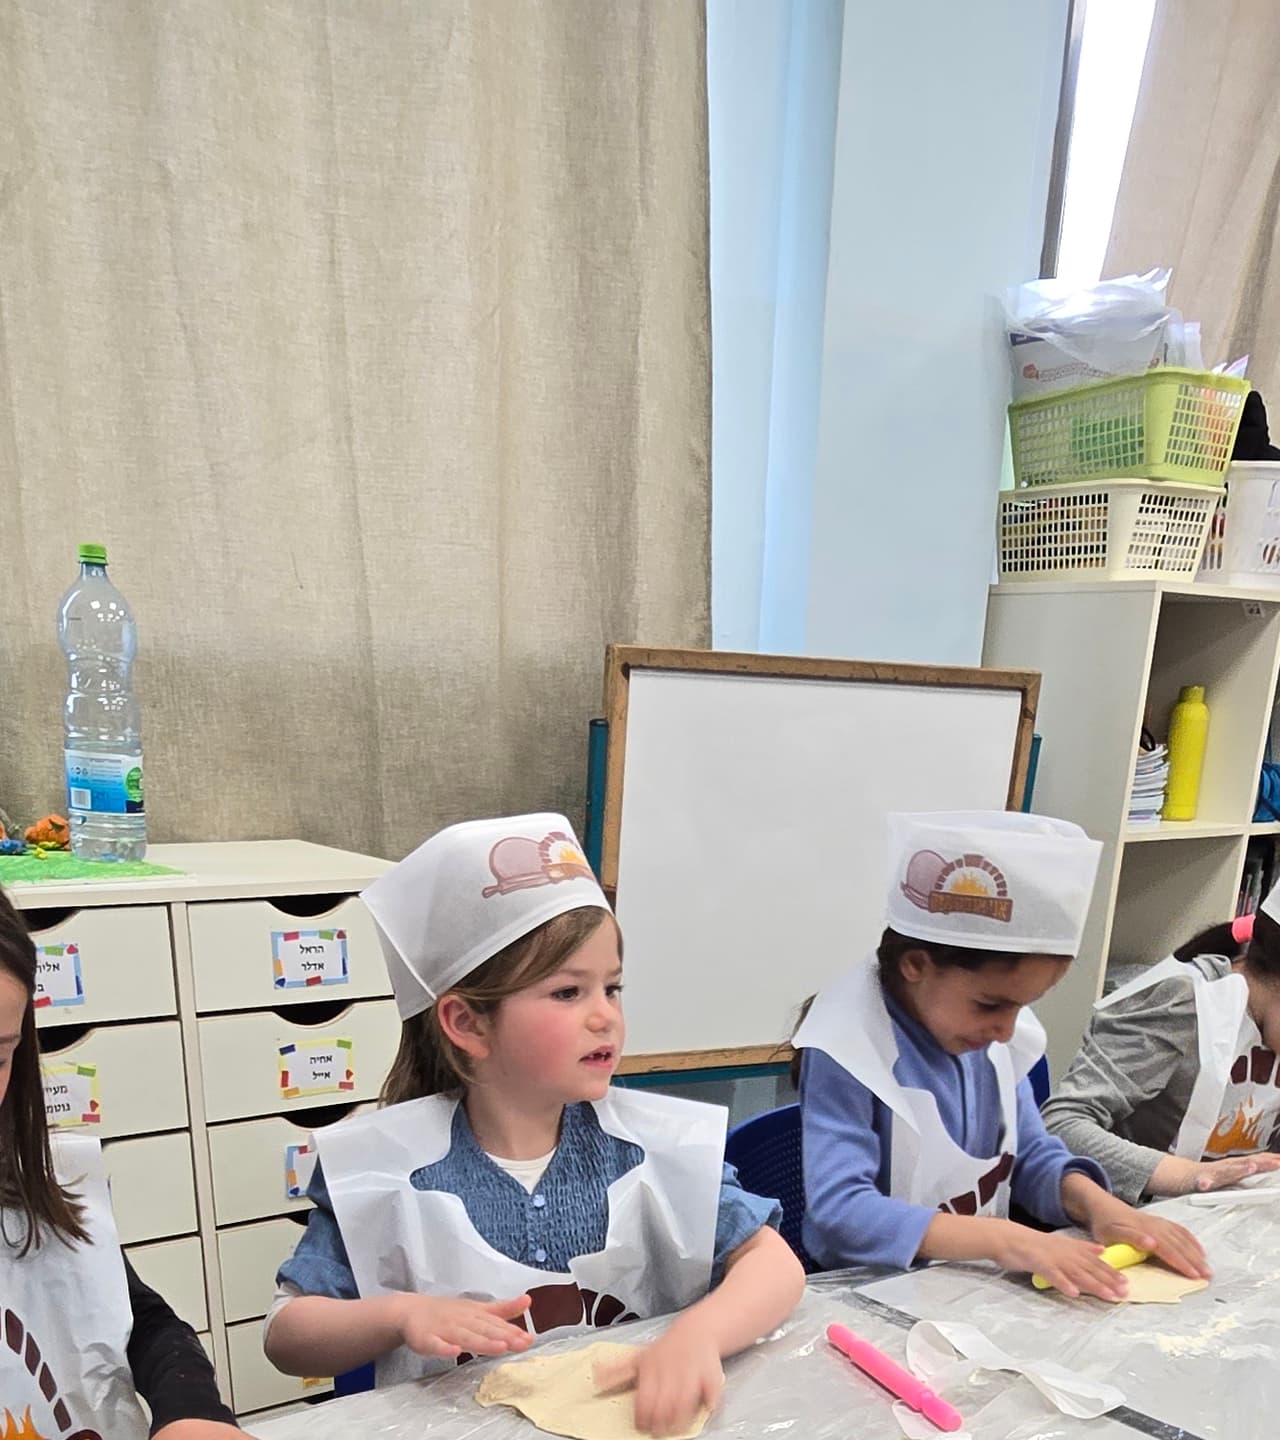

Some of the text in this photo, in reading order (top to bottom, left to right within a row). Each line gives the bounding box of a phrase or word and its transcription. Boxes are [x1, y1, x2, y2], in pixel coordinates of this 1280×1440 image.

[299, 944, 324, 954] הראל
[301, 961, 325, 971] אדלר
[309, 1055, 333, 1065] אחיה
